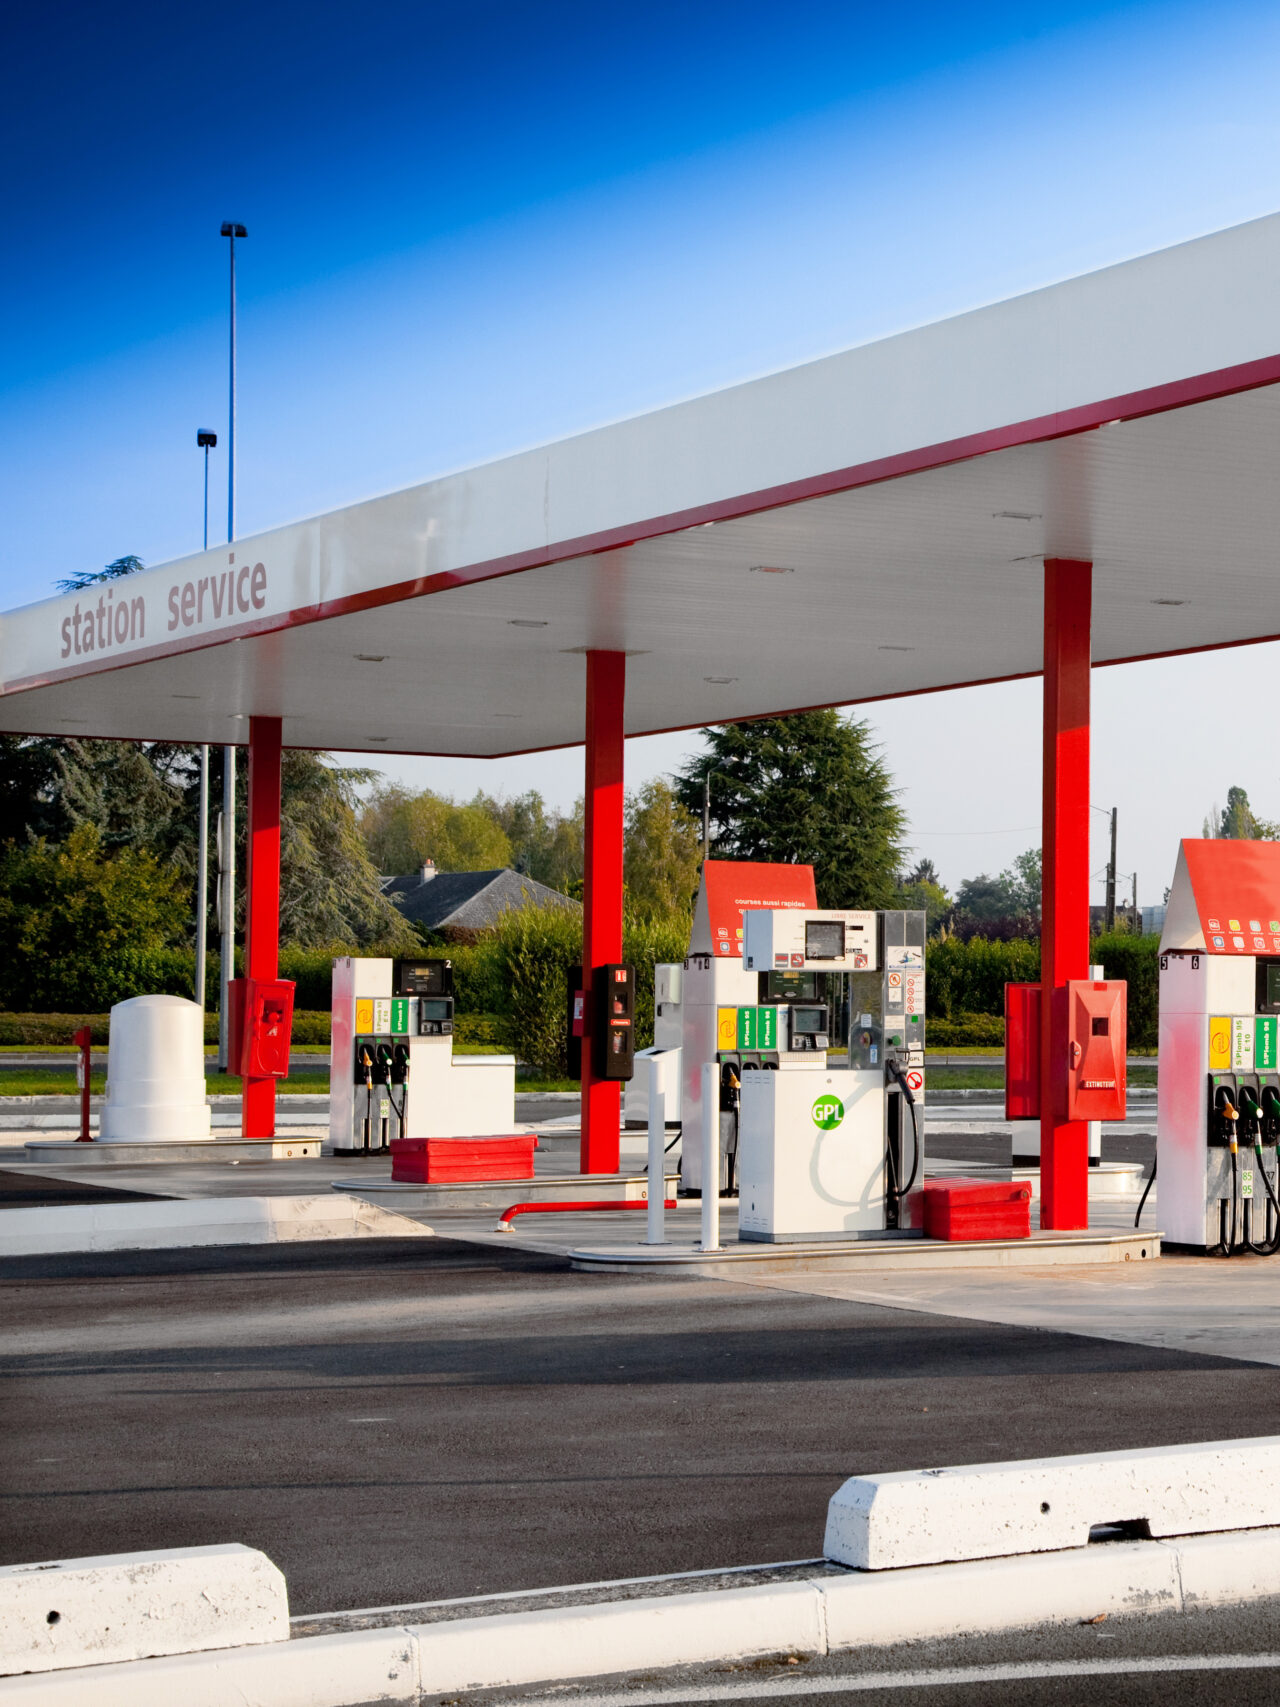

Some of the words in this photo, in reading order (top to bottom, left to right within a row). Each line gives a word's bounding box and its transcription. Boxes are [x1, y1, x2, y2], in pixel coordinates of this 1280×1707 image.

[61, 589, 146, 658] station
[168, 552, 267, 631] service
[781, 900, 806, 908] rapides
[445, 959, 452, 969] 2
[1161, 957, 1167, 969] 5
[1193, 956, 1198, 969] 6
[812, 1104, 842, 1121] GPL
[1242, 1171, 1252, 1181] 85
[1242, 1185, 1252, 1194] 95
